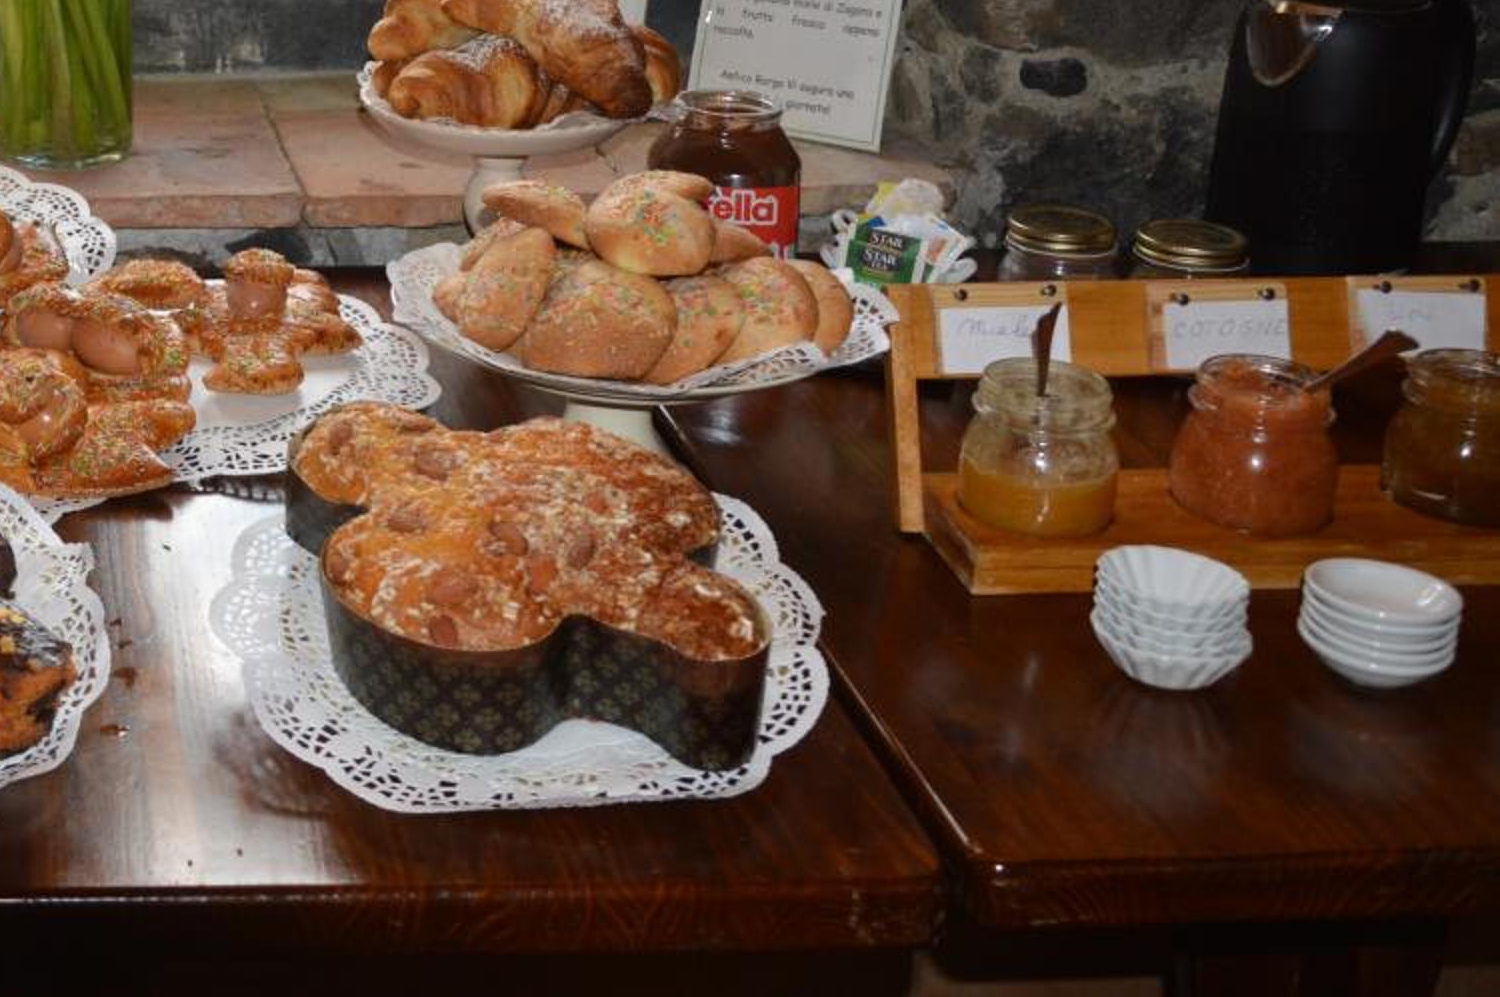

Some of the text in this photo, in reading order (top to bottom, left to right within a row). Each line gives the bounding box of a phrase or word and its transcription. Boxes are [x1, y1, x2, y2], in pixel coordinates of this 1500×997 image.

[742, 8, 773, 22] frutta
[835, 2, 873, 18] Zagara
[719, 67, 753, 83] Antico
[755, 73, 785, 88] Borgo
[798, 82, 834, 97] augura
[836, 89, 855, 100] una
[708, 187, 778, 225] ella
[870, 231, 904, 250] STAR
[861, 249, 898, 267] STAR
